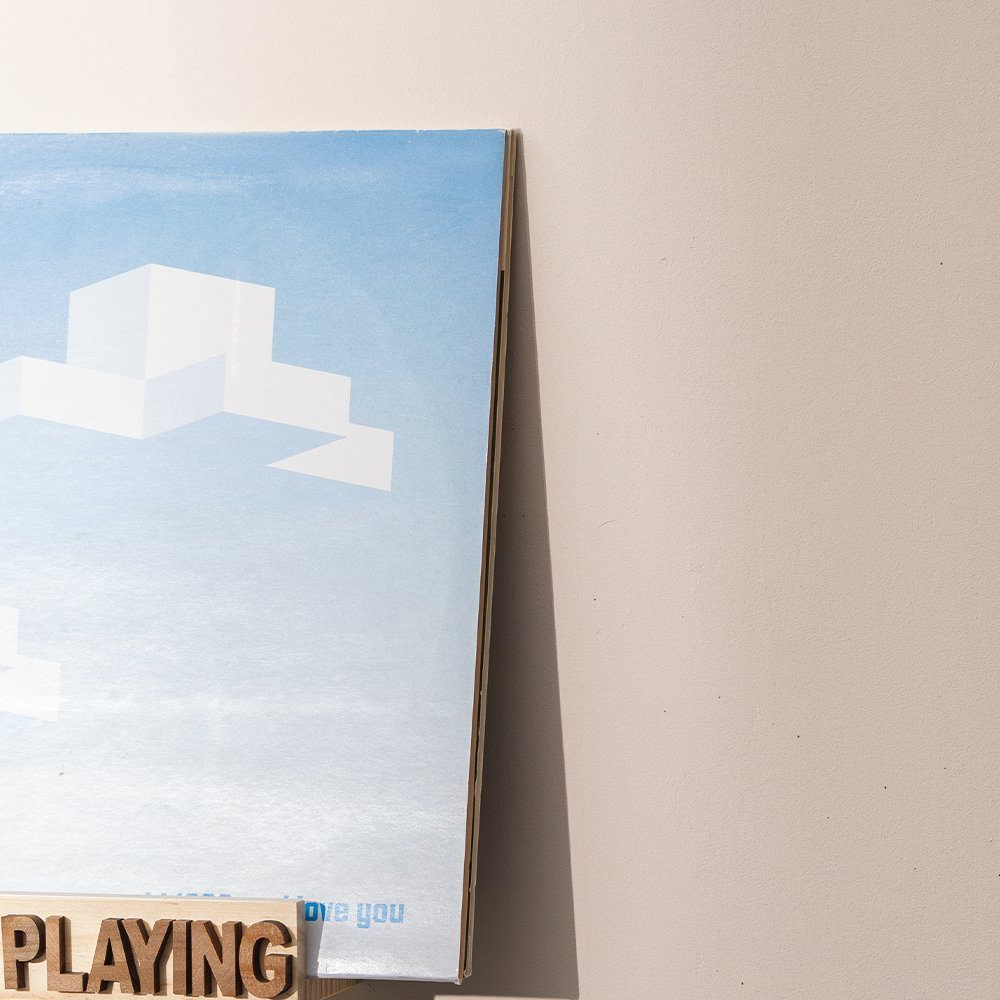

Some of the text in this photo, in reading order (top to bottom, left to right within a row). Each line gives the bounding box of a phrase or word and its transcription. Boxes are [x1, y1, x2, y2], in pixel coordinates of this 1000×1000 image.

[298, 896, 405, 929] ove you
[0, 913, 297, 999] PLAYING
